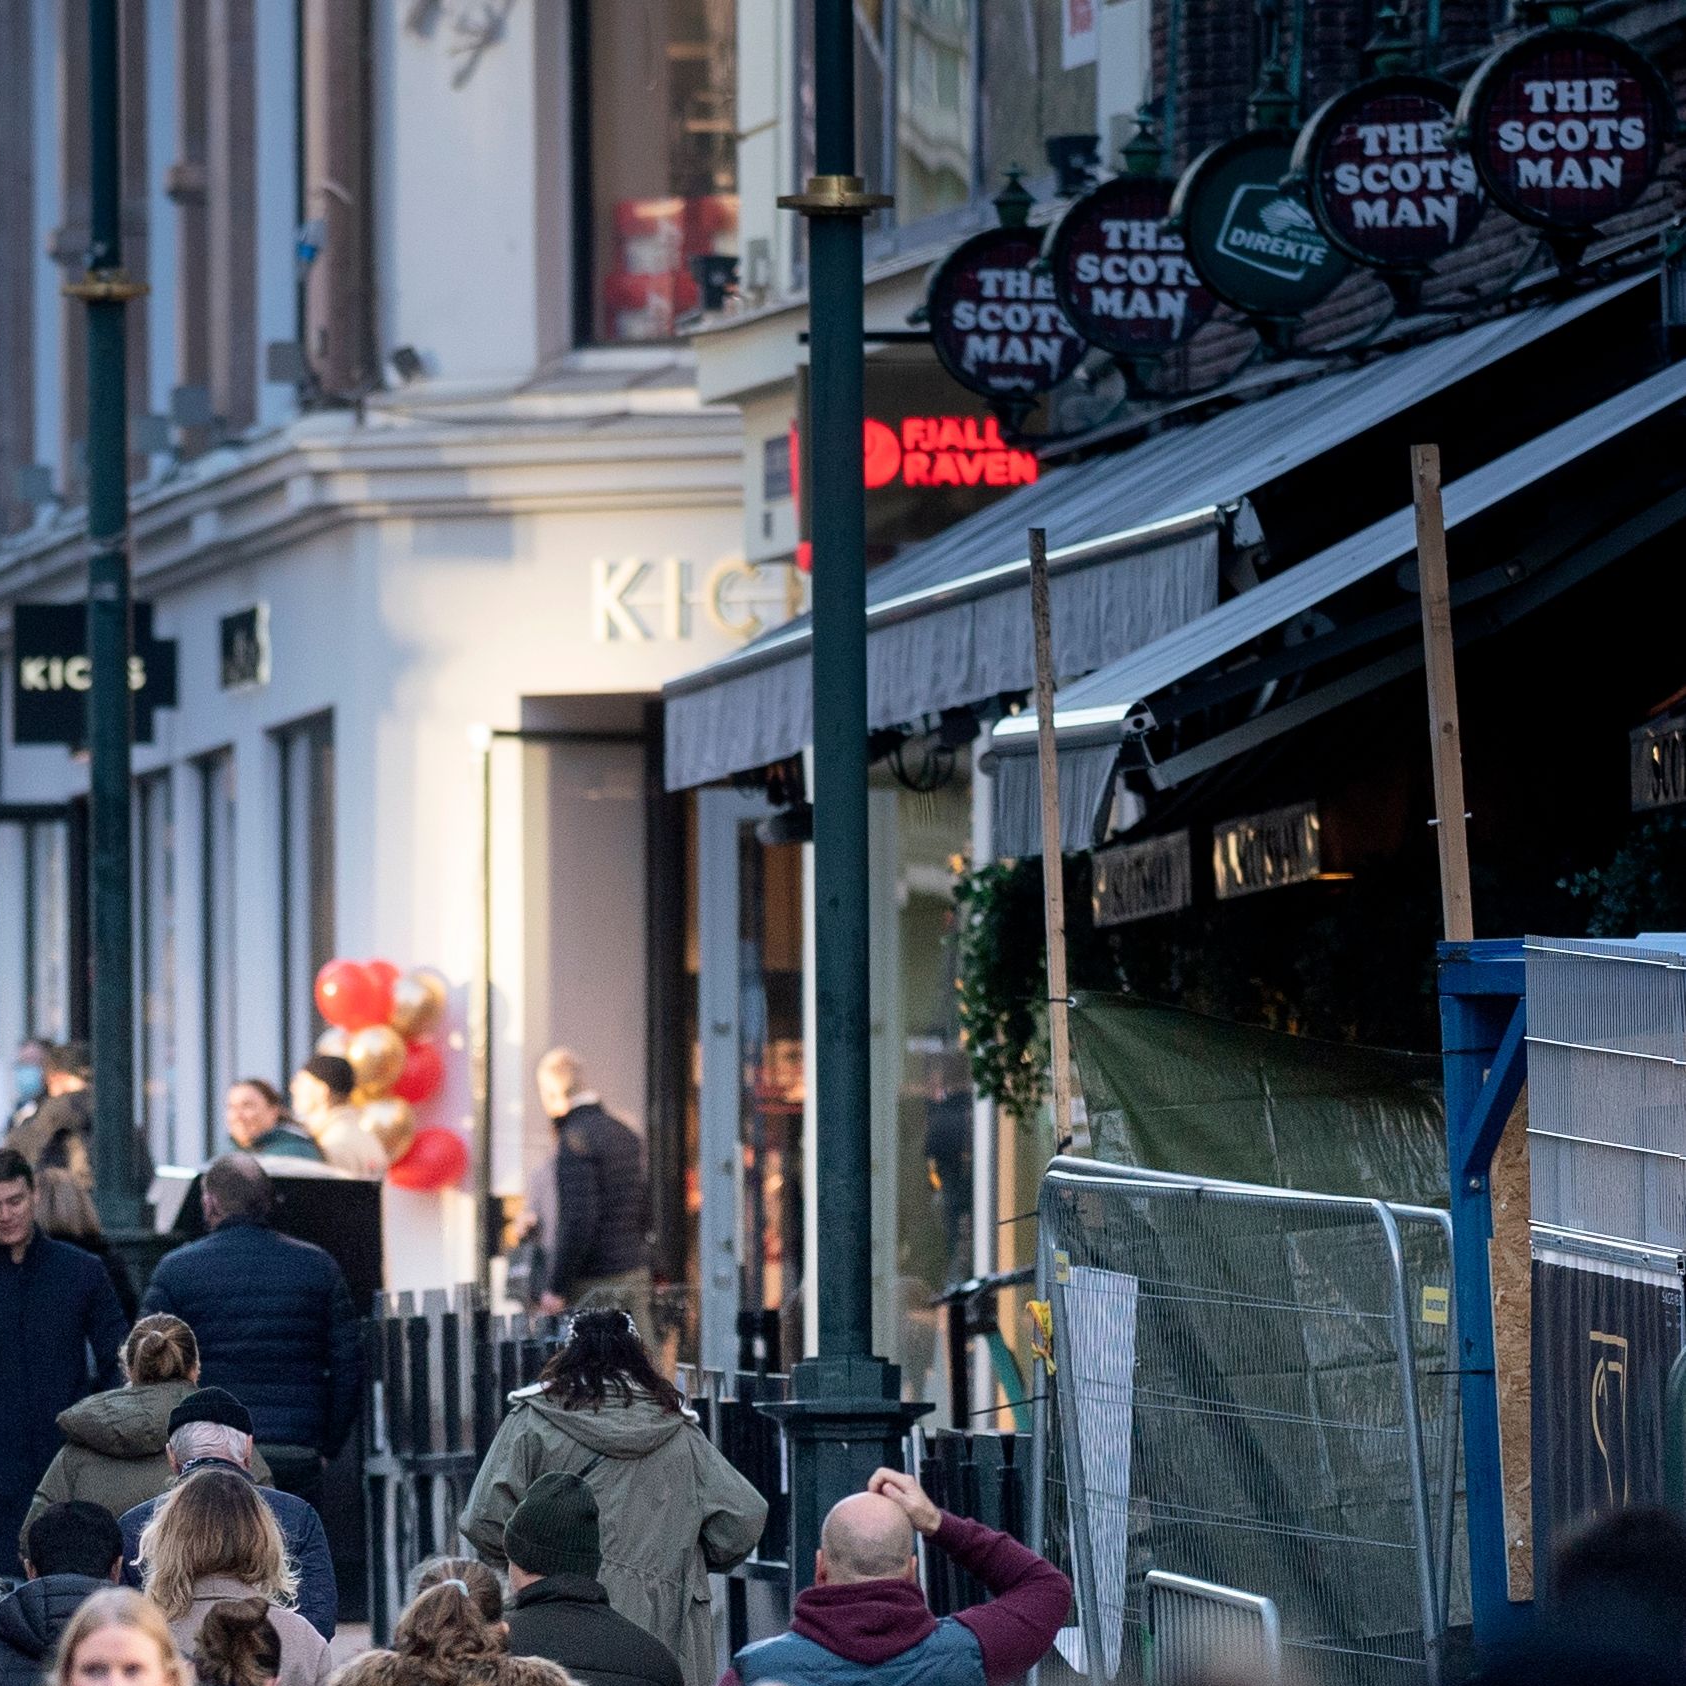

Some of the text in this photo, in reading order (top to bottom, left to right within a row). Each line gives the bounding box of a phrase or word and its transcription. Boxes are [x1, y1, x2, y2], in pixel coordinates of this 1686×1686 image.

[1524, 79, 1620, 114] THE
[1357, 123, 1447, 157] THE
[1499, 118, 1646, 153] SCOTS
[1334, 157, 1479, 195] SCOTS
[1517, 156, 1624, 190] MAN
[1351, 196, 1458, 245] MAN
[1229, 226, 1328, 266] DIREKTE
[1090, 287, 1189, 340] MAN
[962, 334, 1064, 381] MAN
[20, 655, 147, 691] KICS
